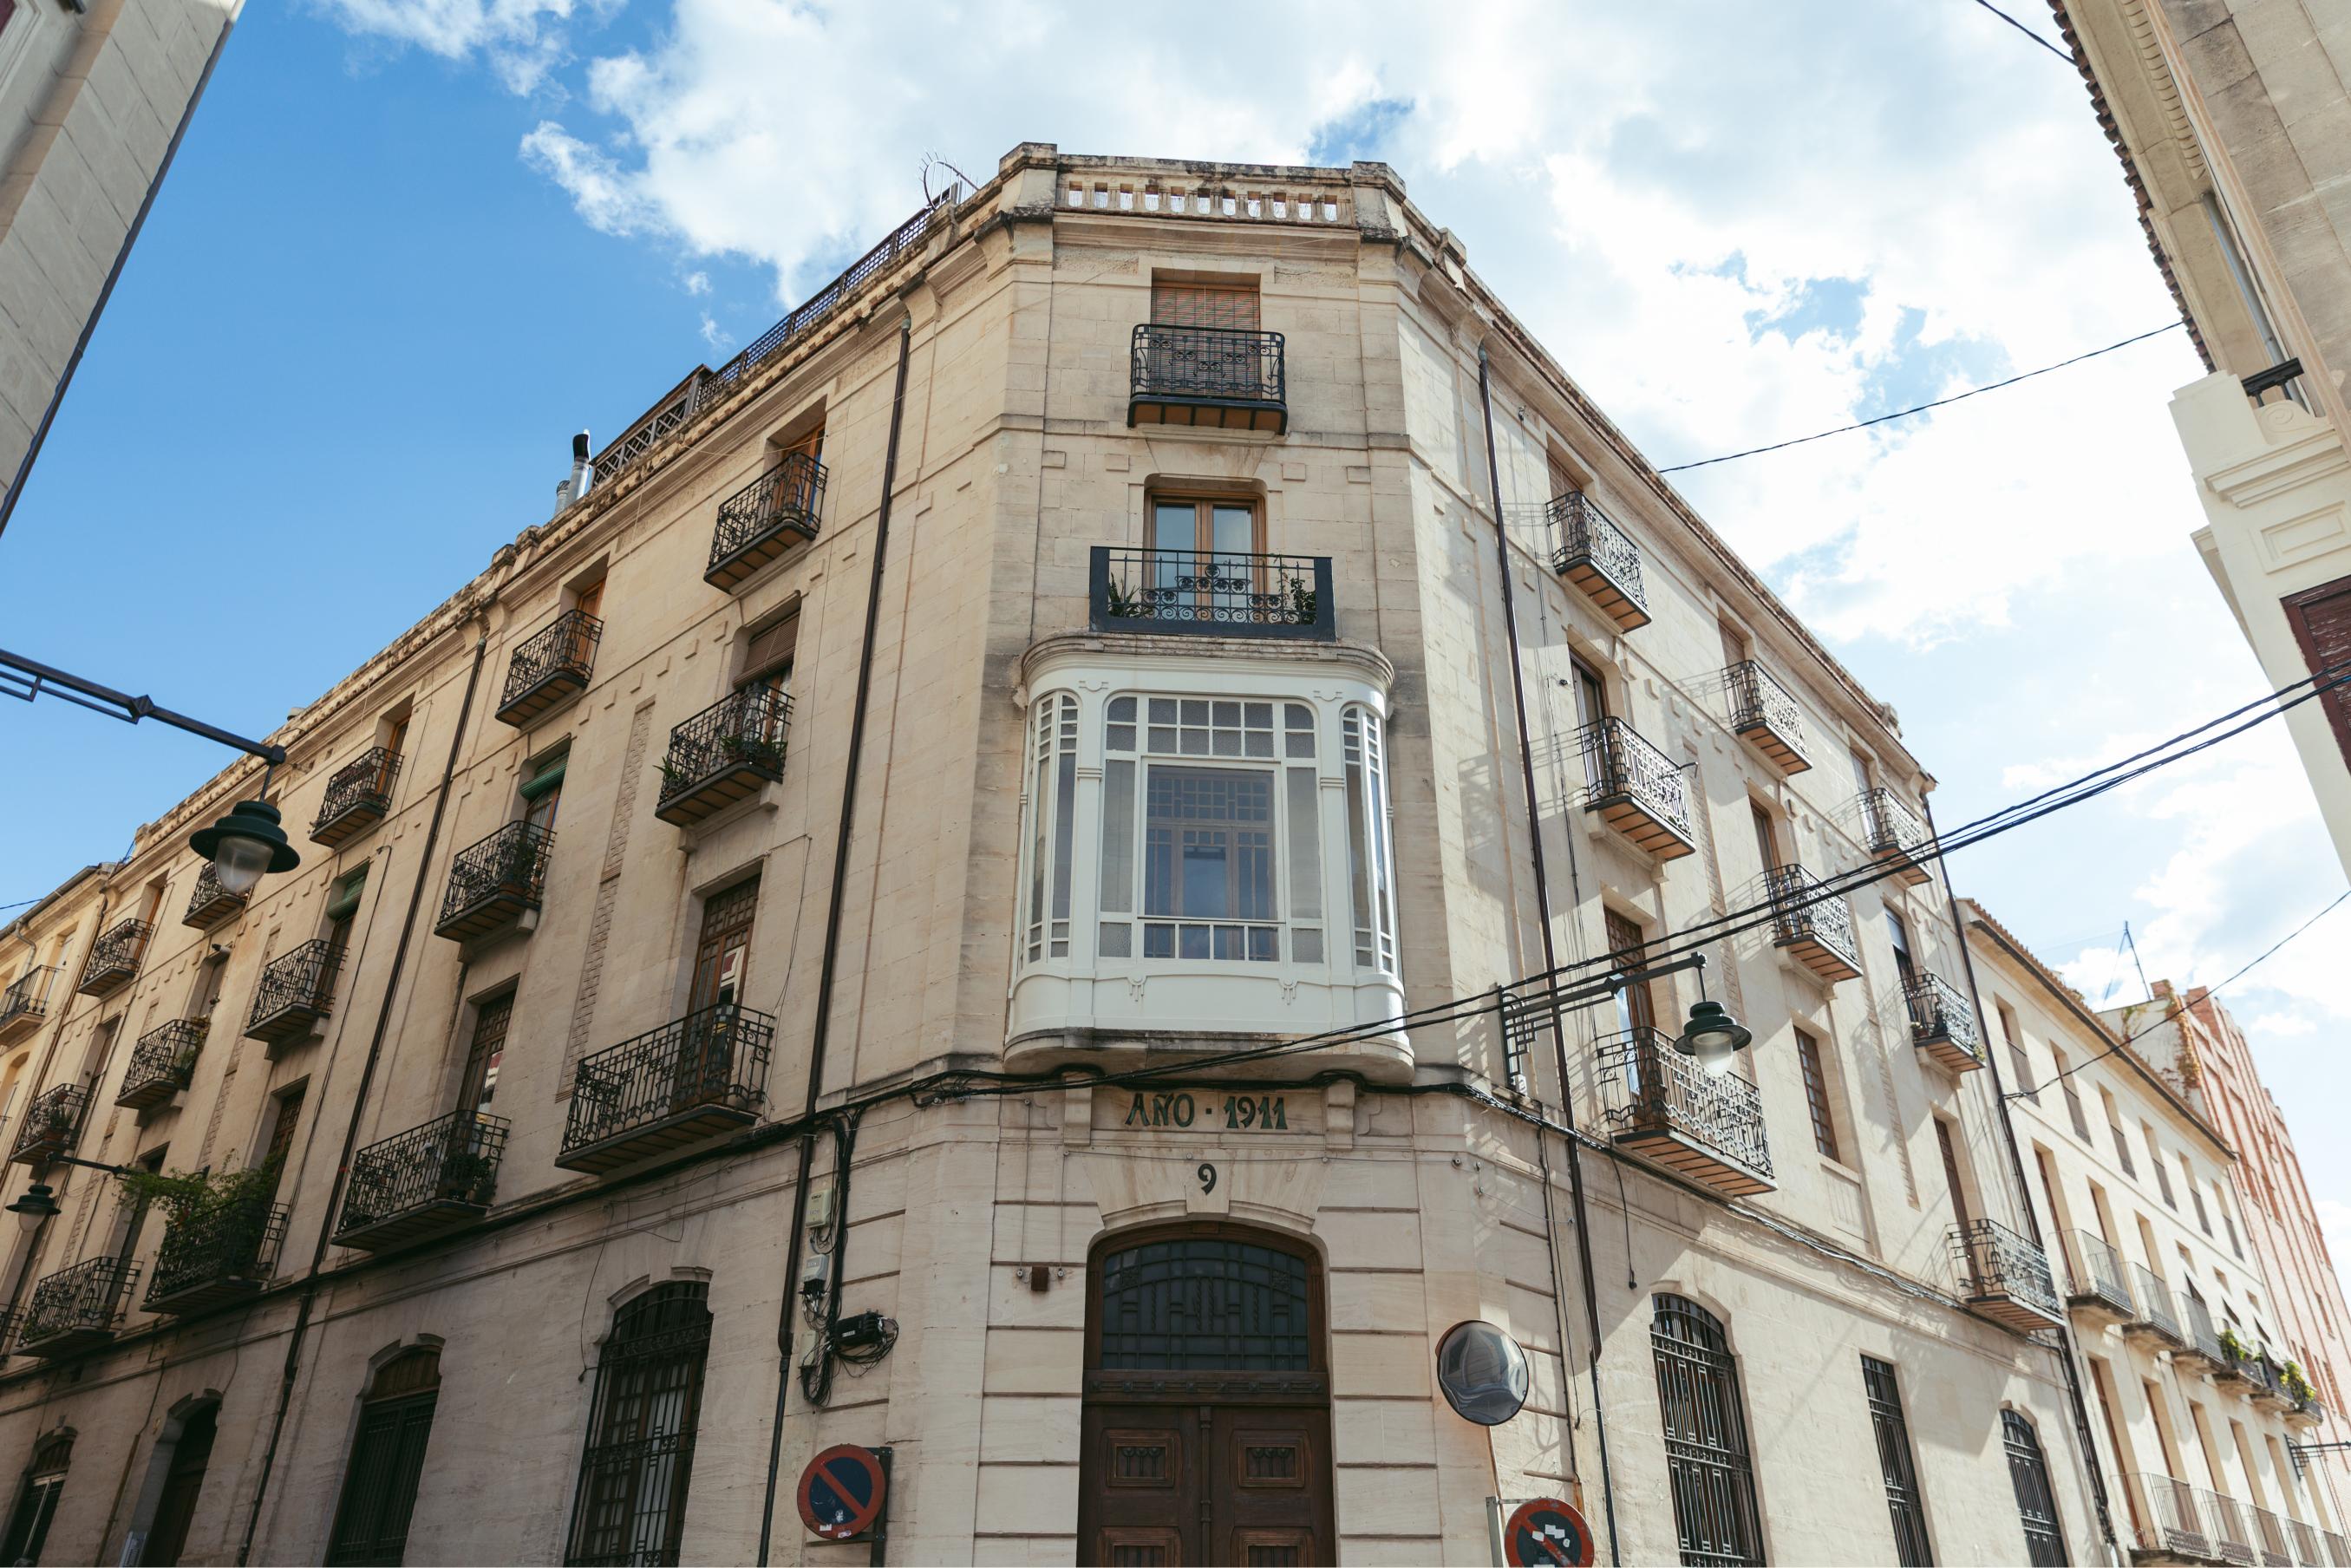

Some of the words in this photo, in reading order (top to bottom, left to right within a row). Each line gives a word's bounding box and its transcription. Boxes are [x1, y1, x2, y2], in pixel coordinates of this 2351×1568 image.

[1125, 1093, 1195, 1127] AÑO
[1224, 1096, 1288, 1130] 1911
[1198, 1163, 1218, 1196] 9
